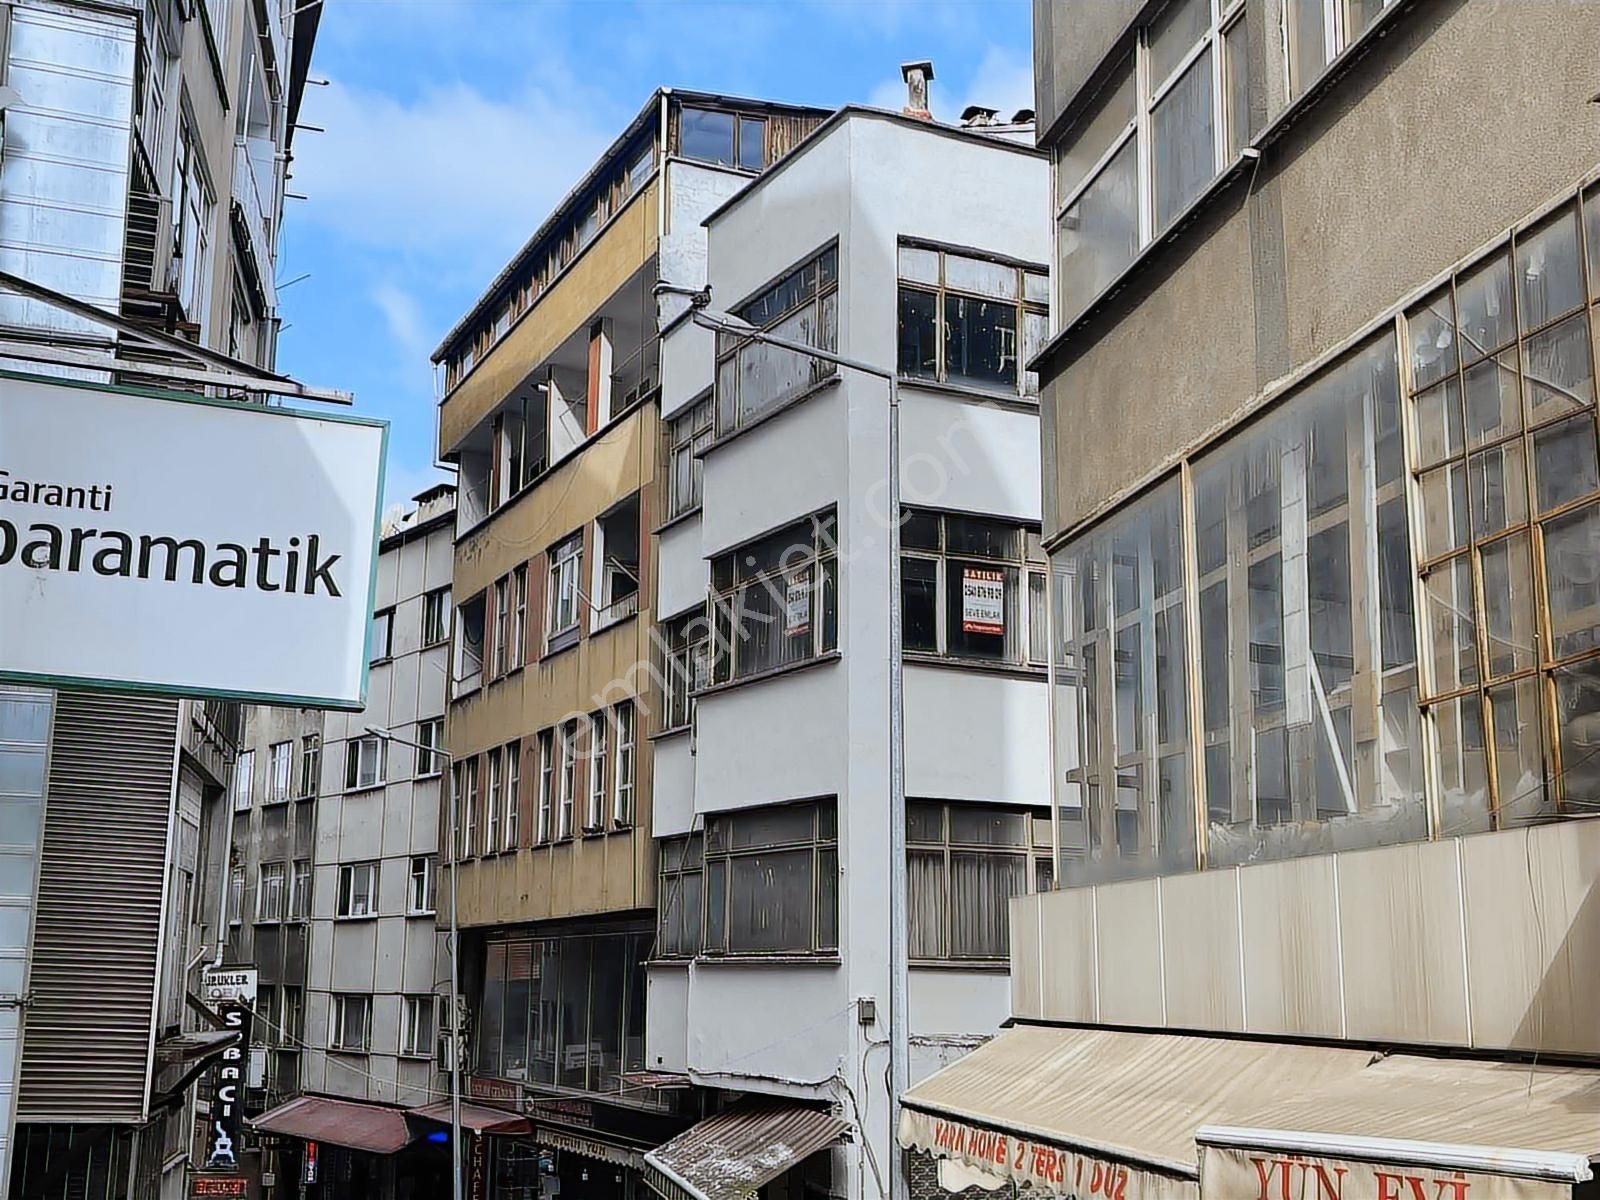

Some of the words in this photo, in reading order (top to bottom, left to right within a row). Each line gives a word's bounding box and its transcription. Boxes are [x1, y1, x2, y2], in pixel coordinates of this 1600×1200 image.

[218, 1011, 243, 1117] SBACI
[967, 1129, 1008, 1165] HOME
[1014, 1141, 1026, 1171] 2
